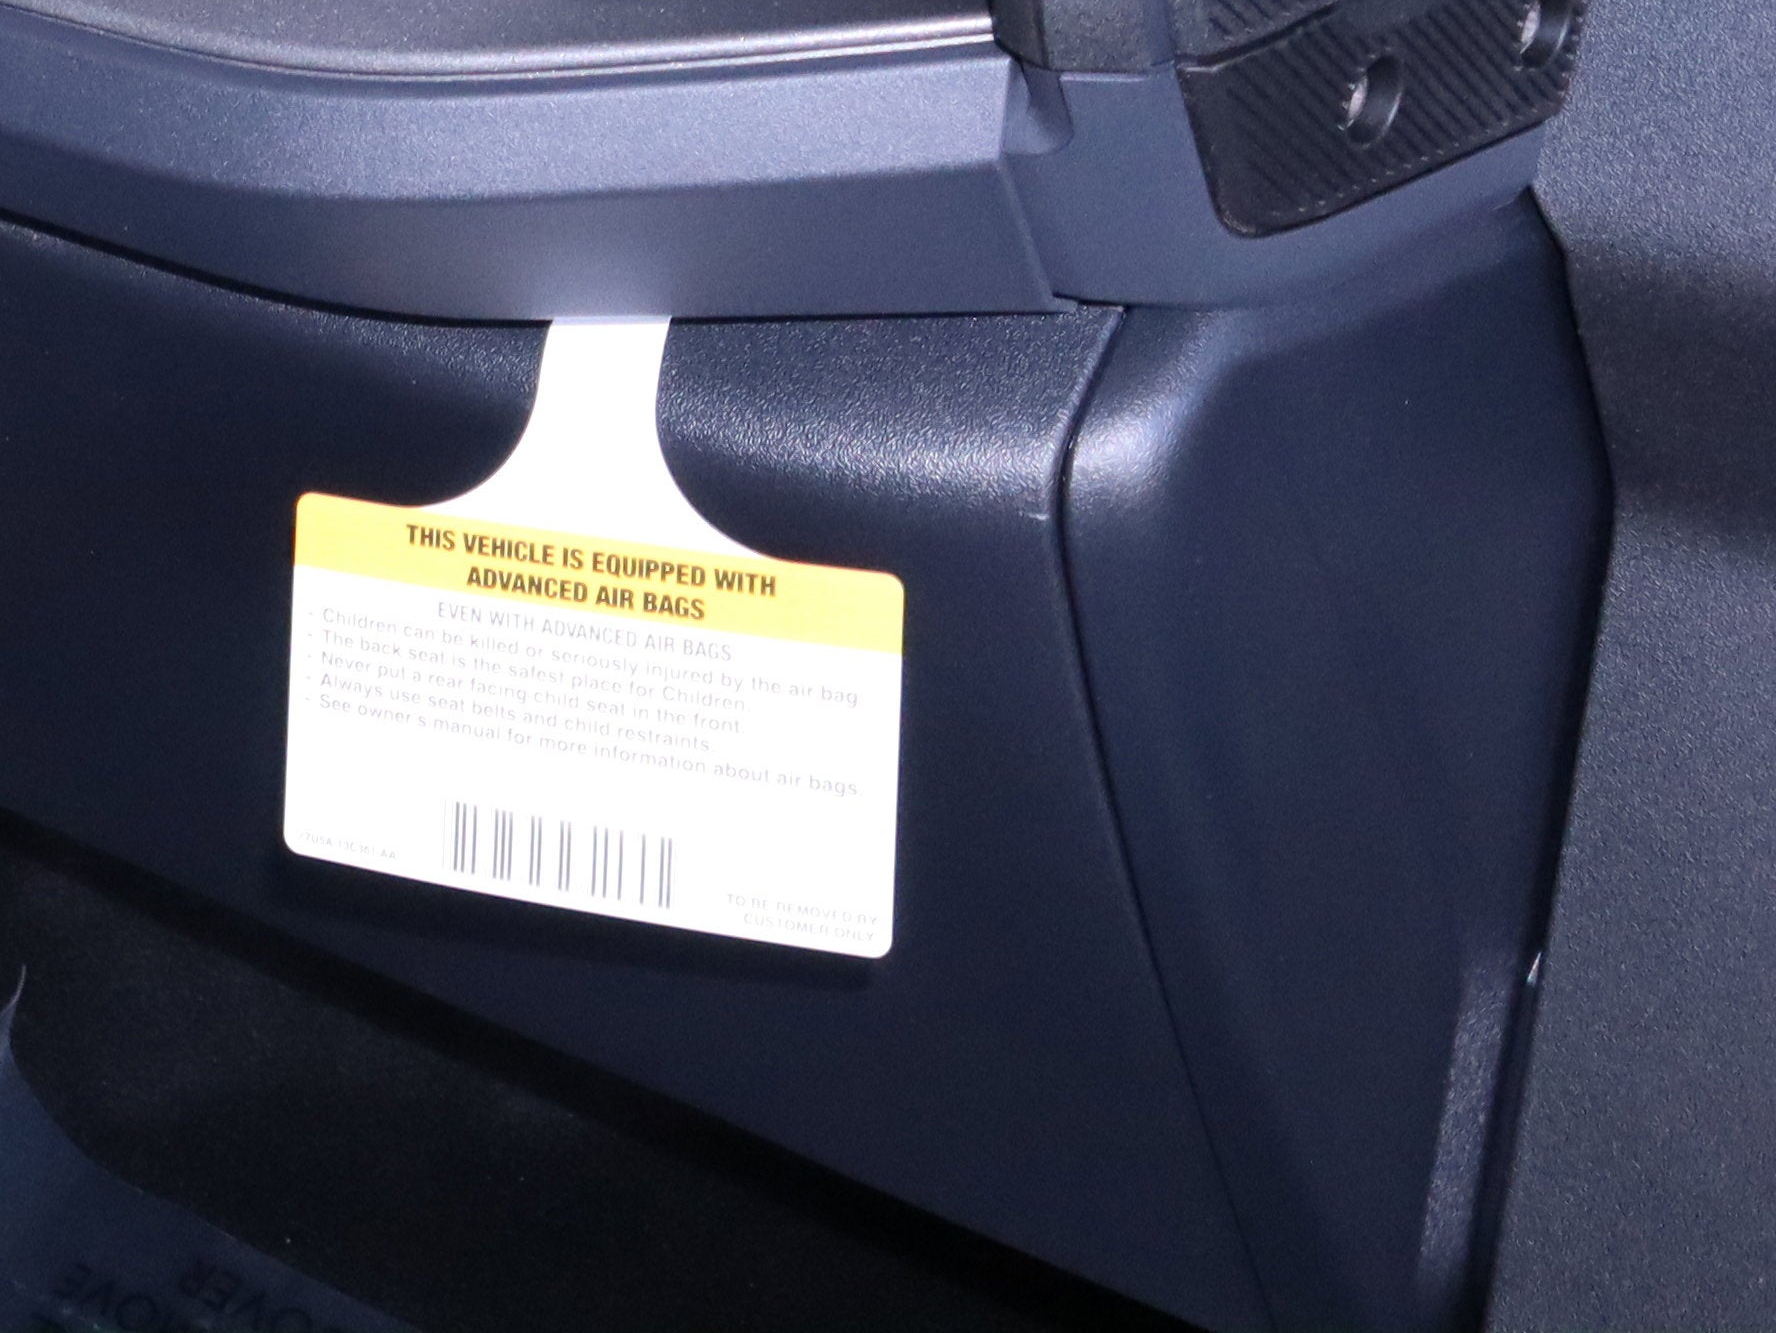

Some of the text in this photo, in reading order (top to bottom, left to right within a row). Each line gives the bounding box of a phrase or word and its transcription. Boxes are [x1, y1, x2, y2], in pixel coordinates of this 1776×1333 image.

[405, 523, 777, 598] THIS VEHICLE IS EQUIPPED WITH
[466, 565, 706, 622] ADVANCED AIR BAGS
[321, 628, 355, 650] The
[359, 635, 402, 659] back
[408, 646, 446, 666] seat
[452, 653, 467, 670] is
[473, 655, 502, 675] the
[508, 664, 566, 685] safest
[571, 672, 623, 695] place
[629, 679, 656, 699] for
[322, 607, 397, 636] Children
[403, 624, 435, 642] can
[441, 630, 464, 646] be
[470, 633, 519, 656] killed
[525, 645, 545, 660] or
[551, 647, 639, 677] seriously
[646, 661, 715, 685] injured
[720, 672, 744, 692] by
[751, 676, 782, 694] the
[788, 681, 815, 699] air
[437, 601, 733, 662] EVEN WITH ADVANCED AIR BAGS
[319, 672, 384, 700] Always
[389, 687, 422, 706] use
[428, 694, 466, 713] seat
[471, 700, 517, 722] belts
[522, 707, 559, 728] and
[564, 715, 611, 738] child
[320, 650, 373, 673] Never
[377, 662, 407, 680] put
[412, 670, 423, 683] a
[427, 672, 465, 691] rear
[470, 676, 528, 704] facing
[533, 688, 580, 710] child
[586, 697, 627, 717] seat
[632, 704, 650, 721] in
[656, 707, 687, 725] the
[319, 692, 352, 714] See
[433, 717, 501, 742] manual
[506, 727, 534, 747] for
[539, 736, 587, 756] more
[594, 744, 707, 774] information
[713, 762, 771, 783] about
[776, 771, 802, 788] air
[727, 893, 880, 926] TO BE REMOVED BY
[743, 912, 875, 942] CUSTOMER ONLY
